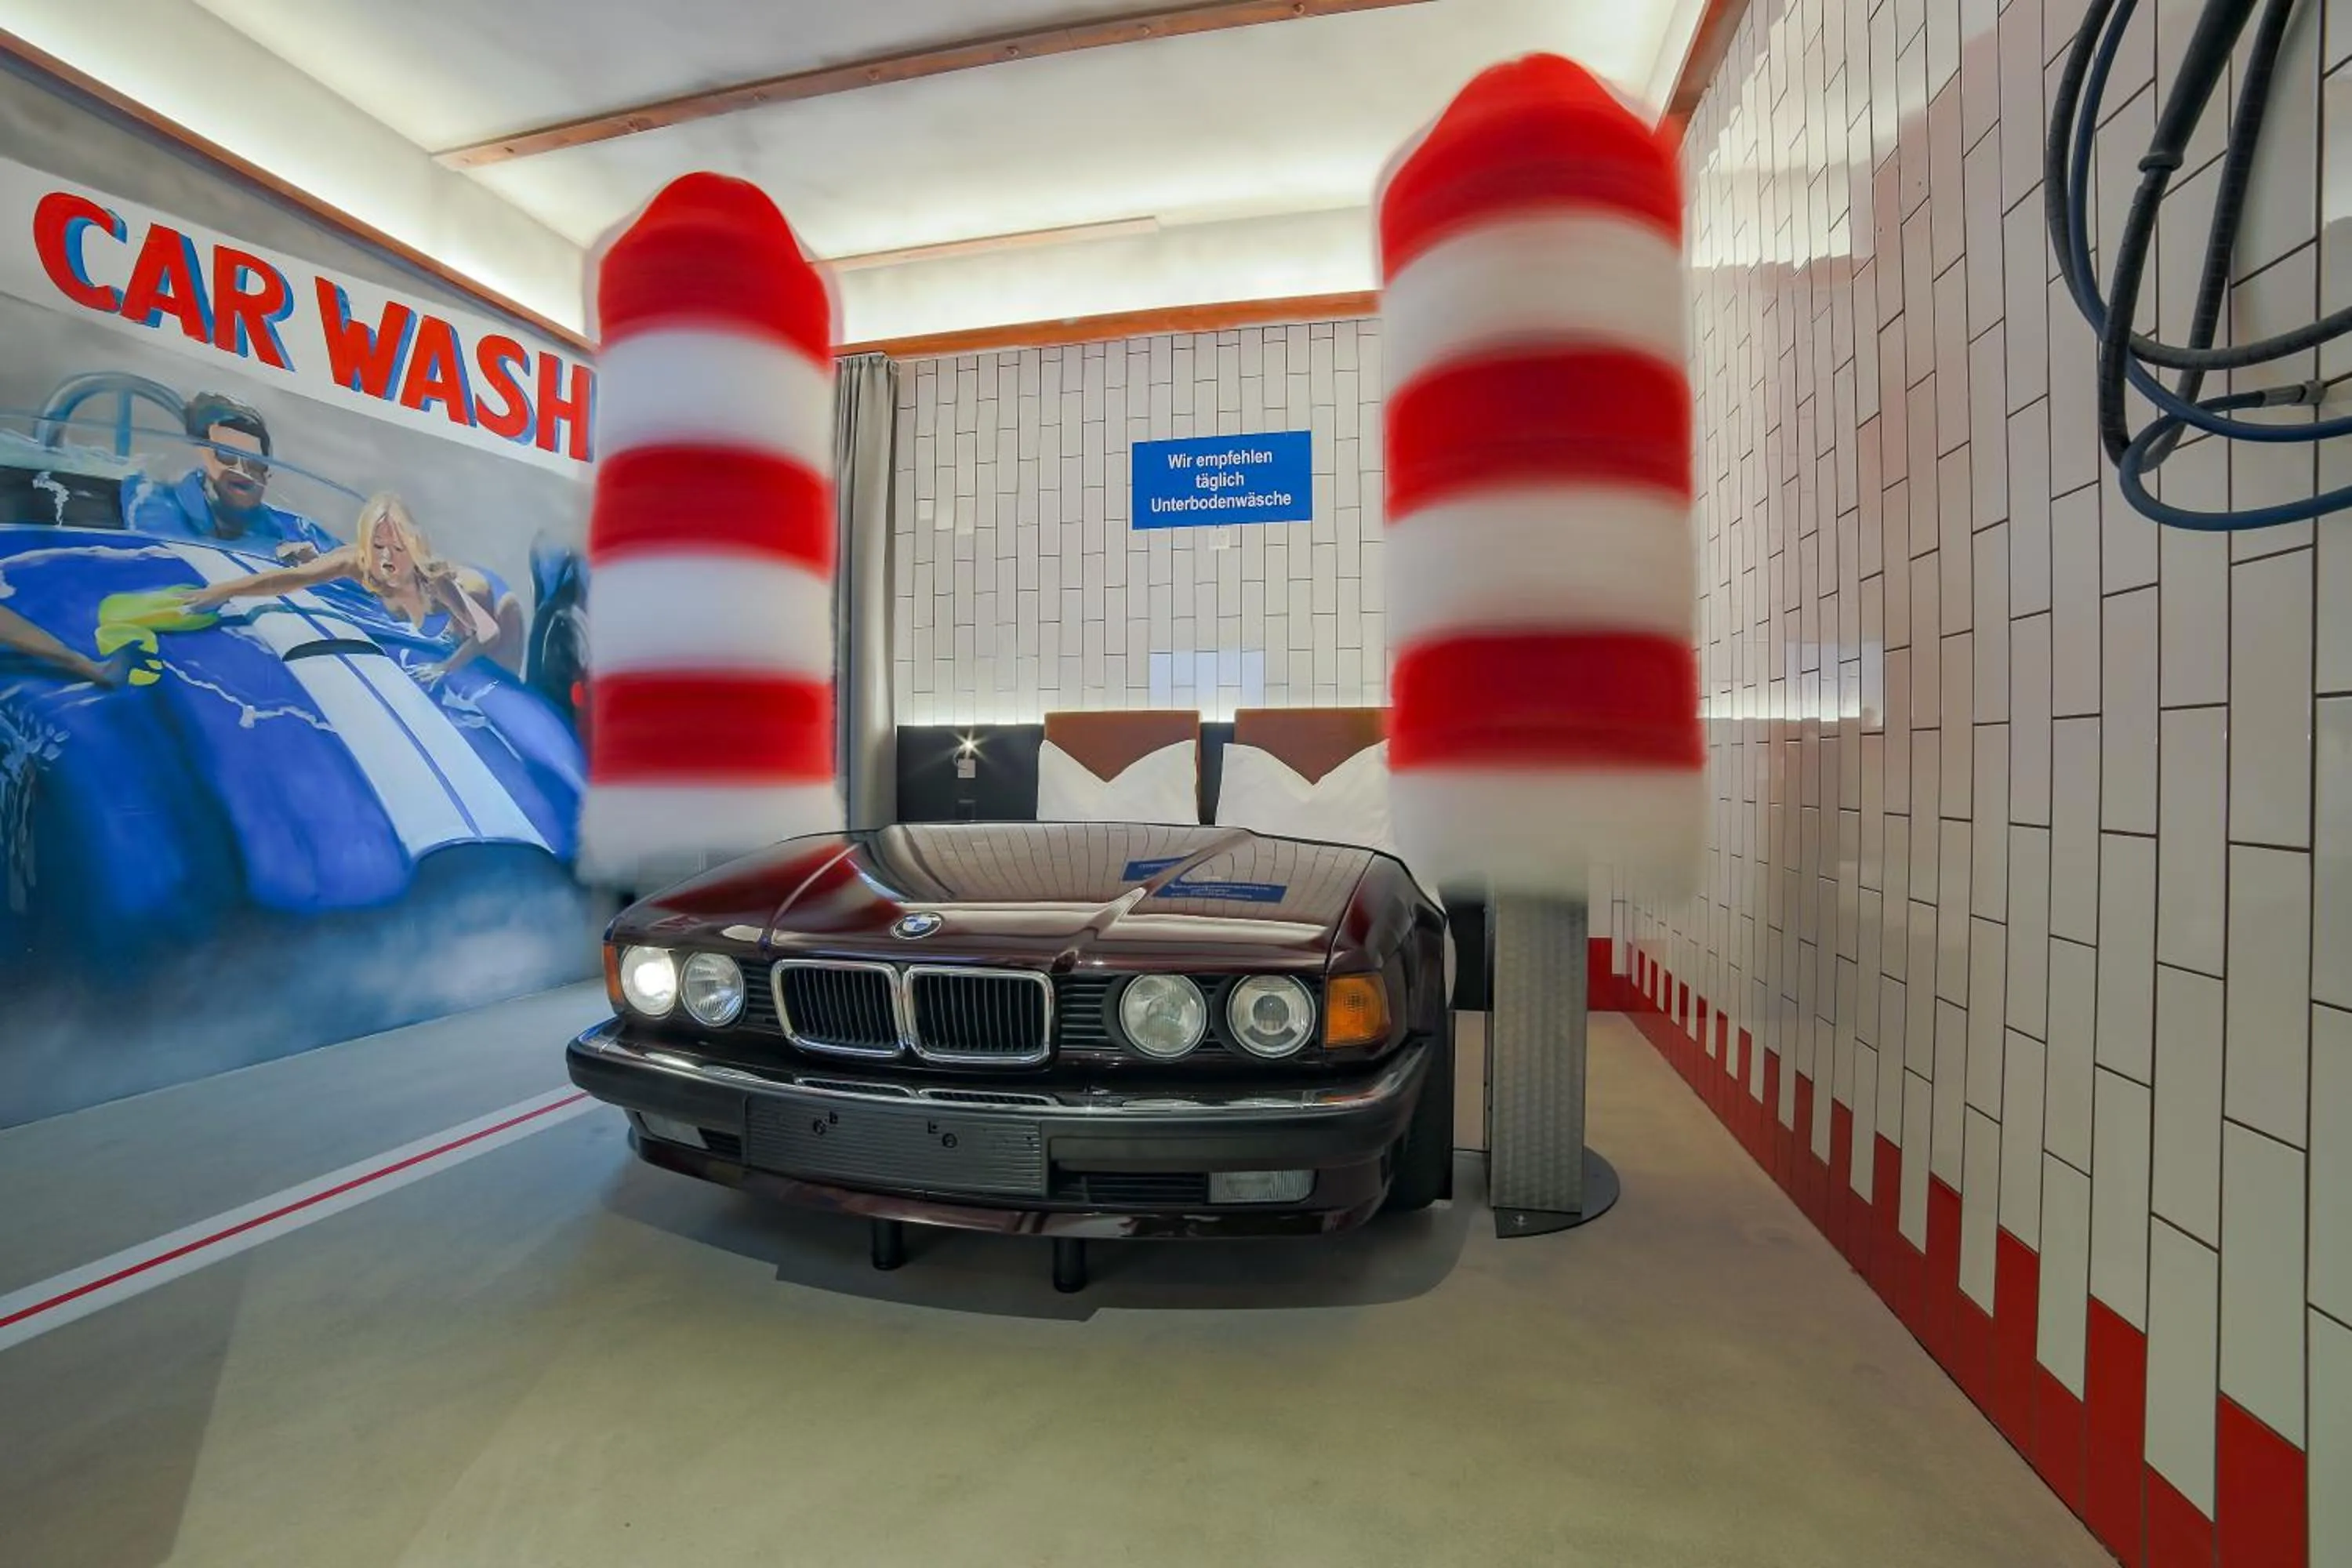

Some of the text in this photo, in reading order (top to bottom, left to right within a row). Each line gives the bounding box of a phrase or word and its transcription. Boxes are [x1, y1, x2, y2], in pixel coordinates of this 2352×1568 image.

[33, 191, 597, 463] CAR WASH
[1167, 449, 1272, 469] Wir empfehlen
[1196, 472, 1244, 491] täglich
[1151, 491, 1291, 513] Unterbodenwäsche
